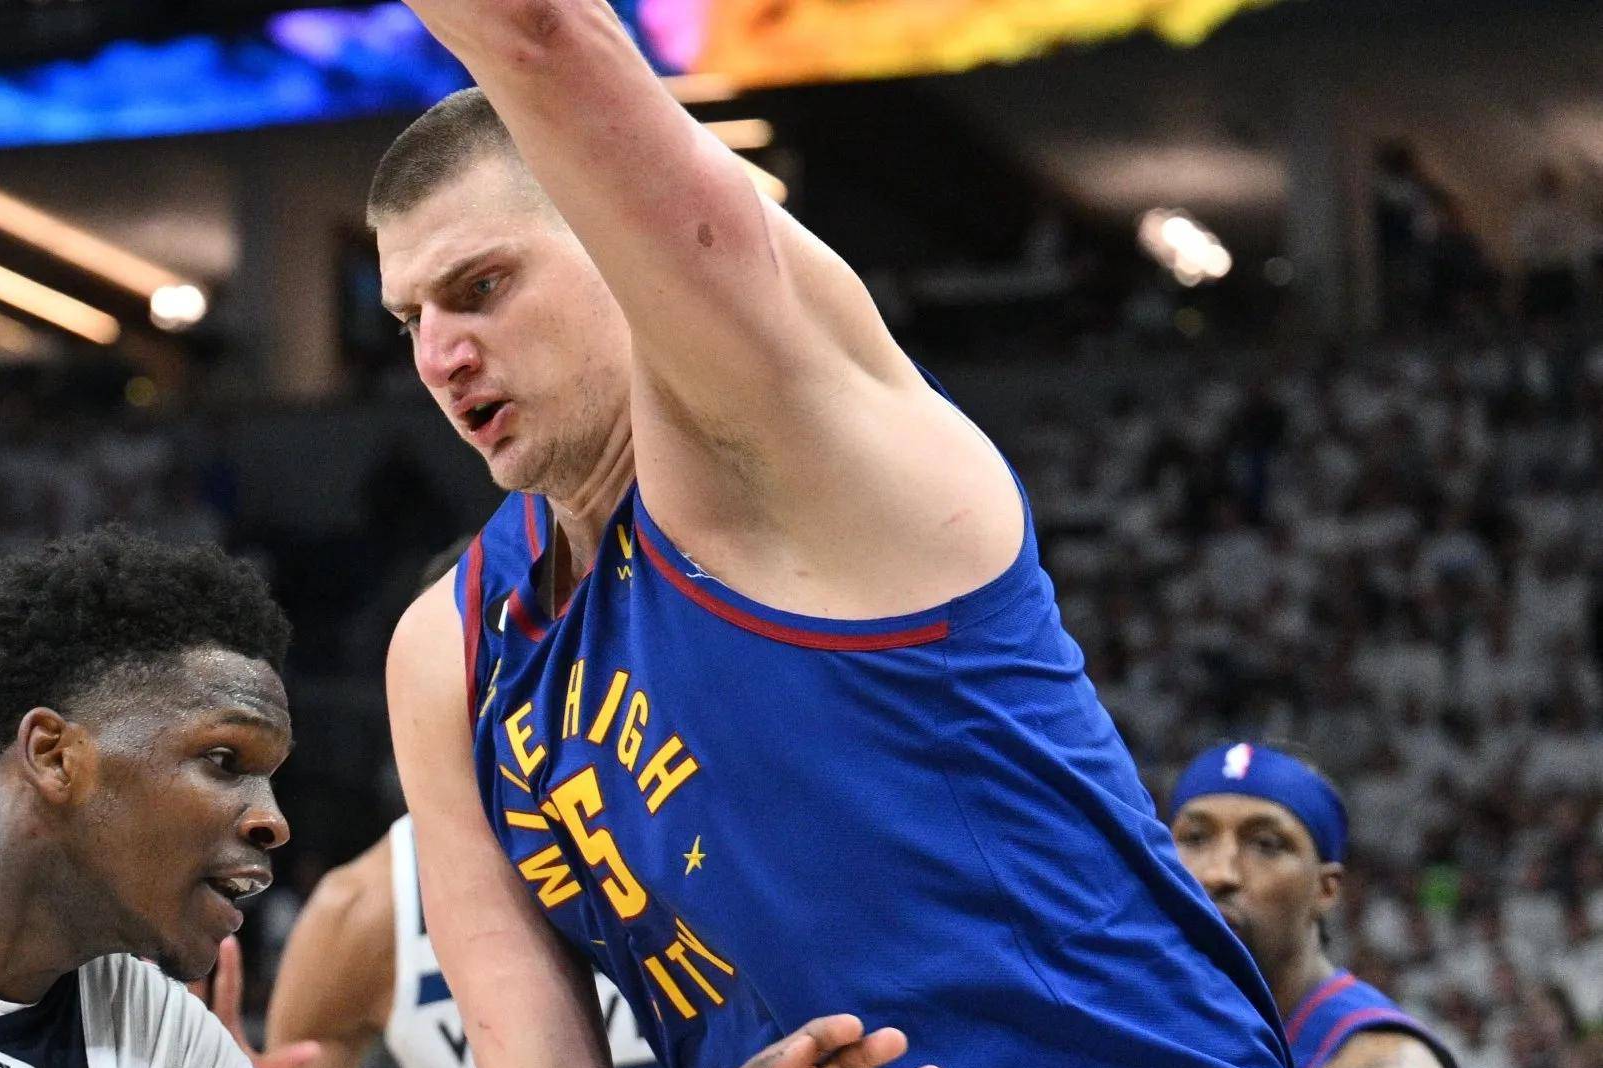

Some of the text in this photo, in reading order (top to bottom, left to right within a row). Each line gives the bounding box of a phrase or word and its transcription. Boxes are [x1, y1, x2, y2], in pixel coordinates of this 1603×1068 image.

[561, 658, 699, 814] HIGH
[541, 765, 647, 919] 5
[645, 917, 735, 1020] ITY
